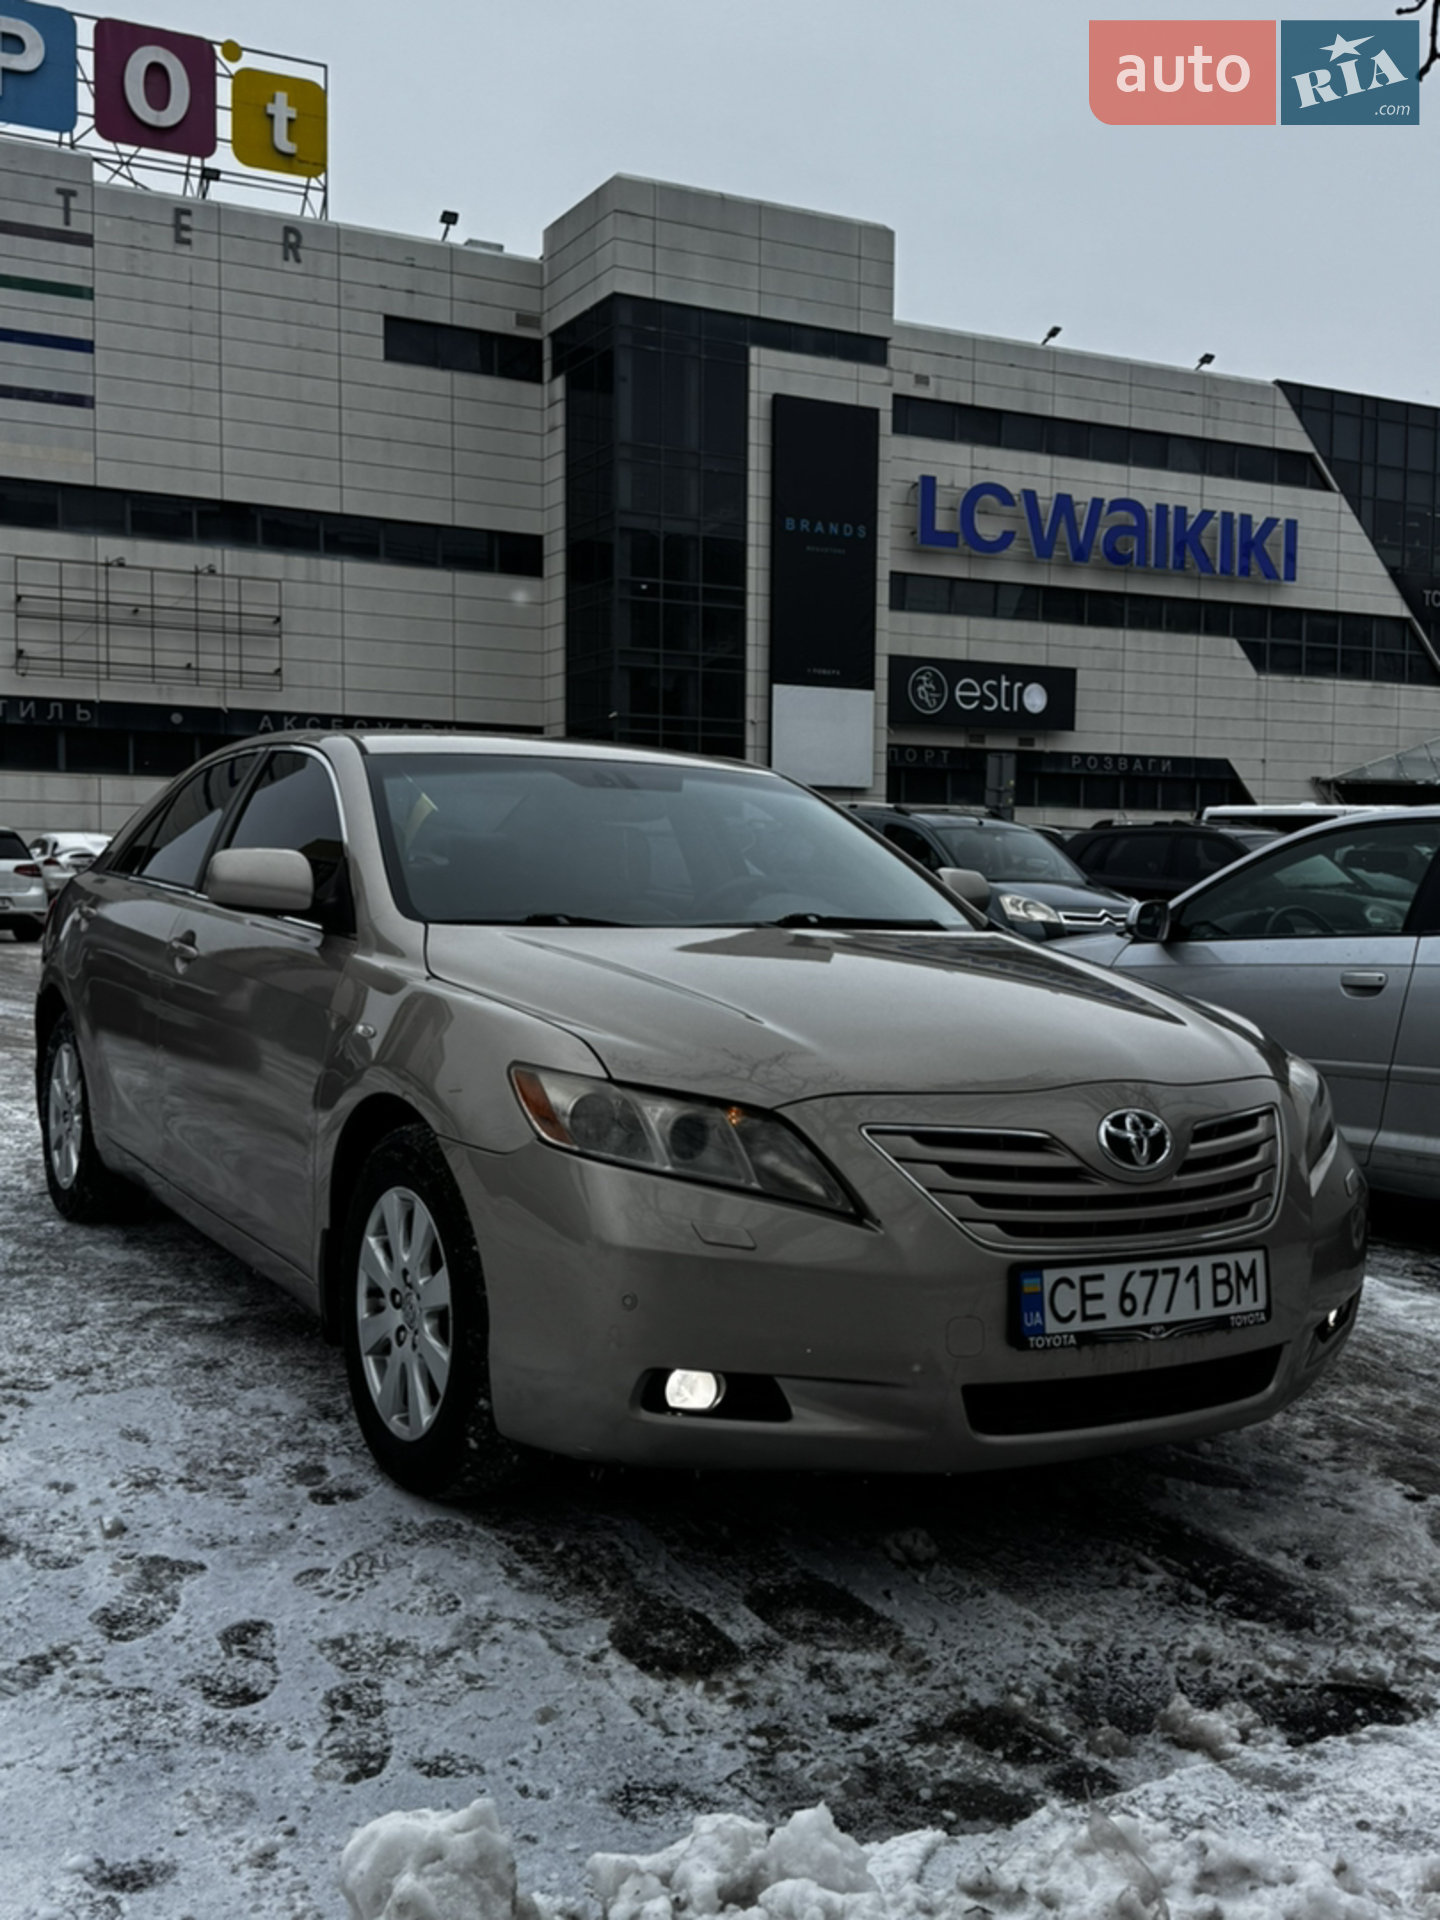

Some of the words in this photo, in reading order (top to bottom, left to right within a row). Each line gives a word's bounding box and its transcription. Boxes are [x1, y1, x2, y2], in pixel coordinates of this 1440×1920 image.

[785, 516, 867, 539] BRANDS
[955, 674, 1047, 713] estro
[1071, 756, 1172, 773] РОЗВАГИ
[1048, 1273, 1107, 1324] CE
[1119, 1264, 1200, 1317] 6771
[1211, 1258, 1258, 1308] BM
[1024, 1312, 1043, 1327] UA
[1230, 1312, 1266, 1326] TOYOTA
[1029, 1334, 1076, 1348] TOYOTA
